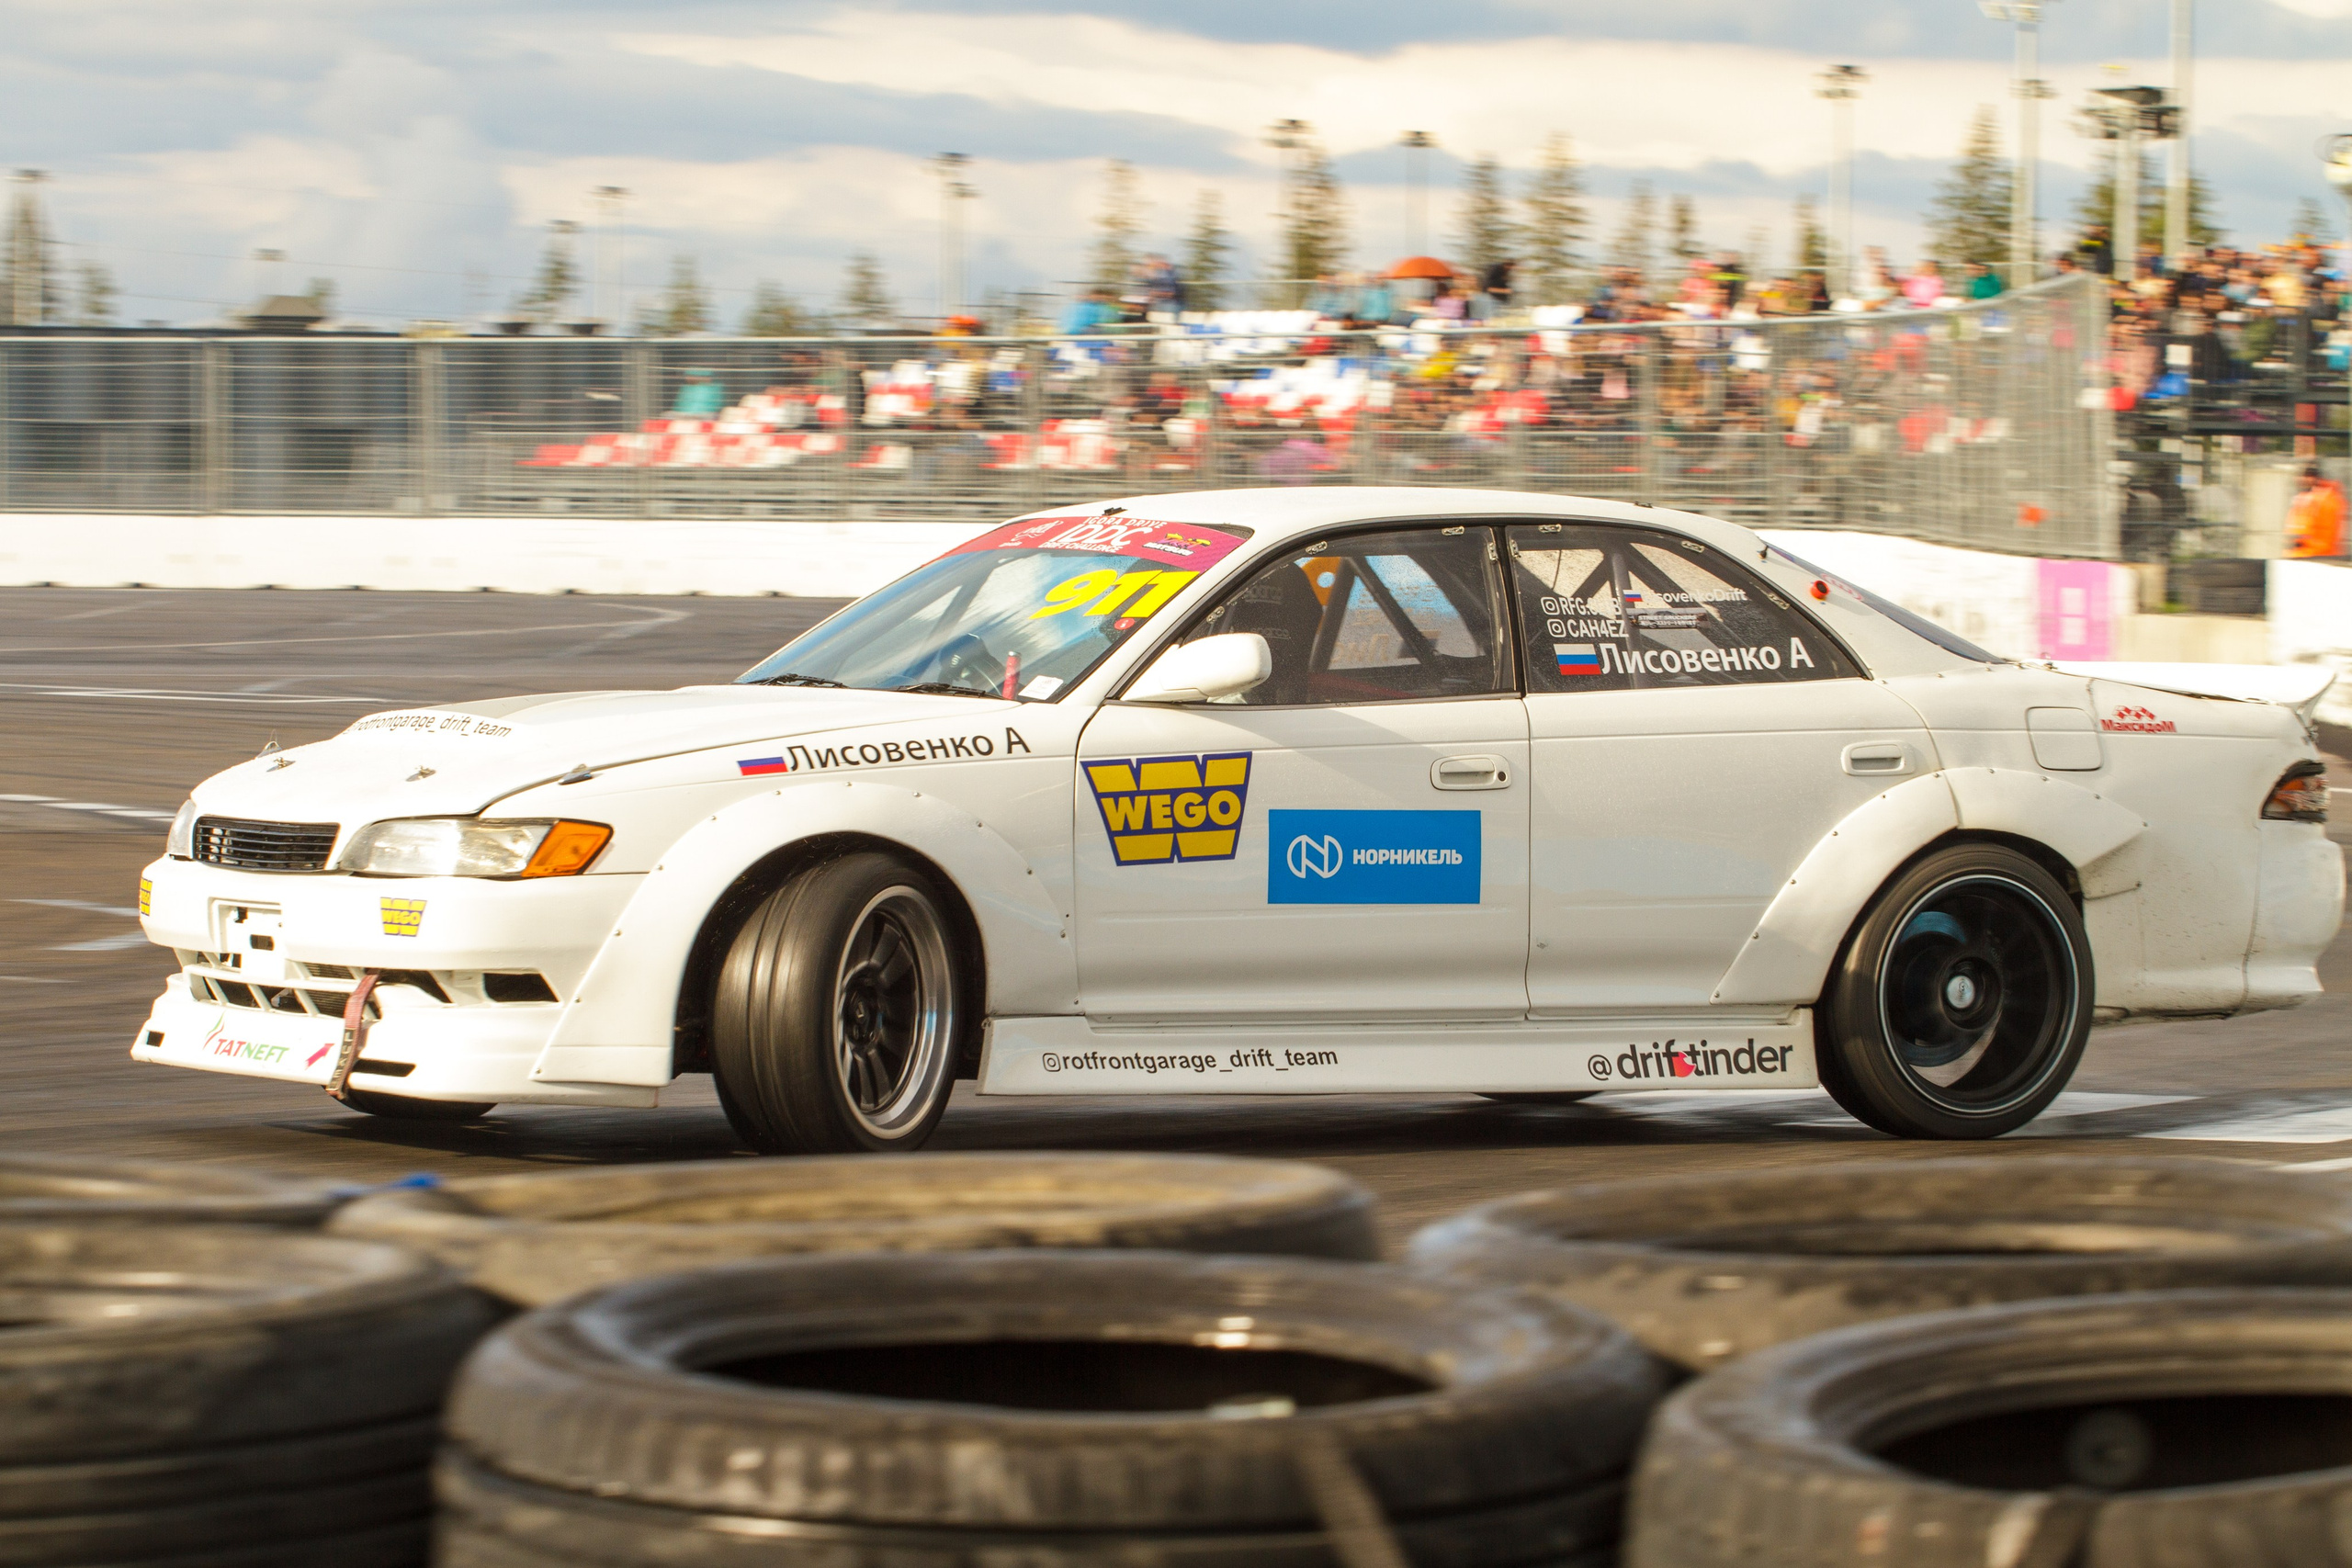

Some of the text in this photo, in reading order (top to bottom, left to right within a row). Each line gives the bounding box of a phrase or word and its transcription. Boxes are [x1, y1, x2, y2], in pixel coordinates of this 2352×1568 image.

[1082, 515, 1168, 529] IGORA DRIVE
[1048, 523, 1153, 547] IDDC
[1038, 541, 1124, 553] DRIFT CHALLENGE
[1028, 569, 1201, 620] 911
[1645, 588, 1747, 604] sovenkoDrift
[1566, 618, 1630, 637] CAH4EZ
[1601, 643, 1781, 675] Лисовенко
[787, 735, 994, 772] Лисовенко
[1100, 790, 1242, 832] WEGO
[1352, 849, 1464, 865] НОРНИКЕЛЬ
[380, 909, 422, 926] WEGO
[213, 1038, 289, 1064] TATNEFT
